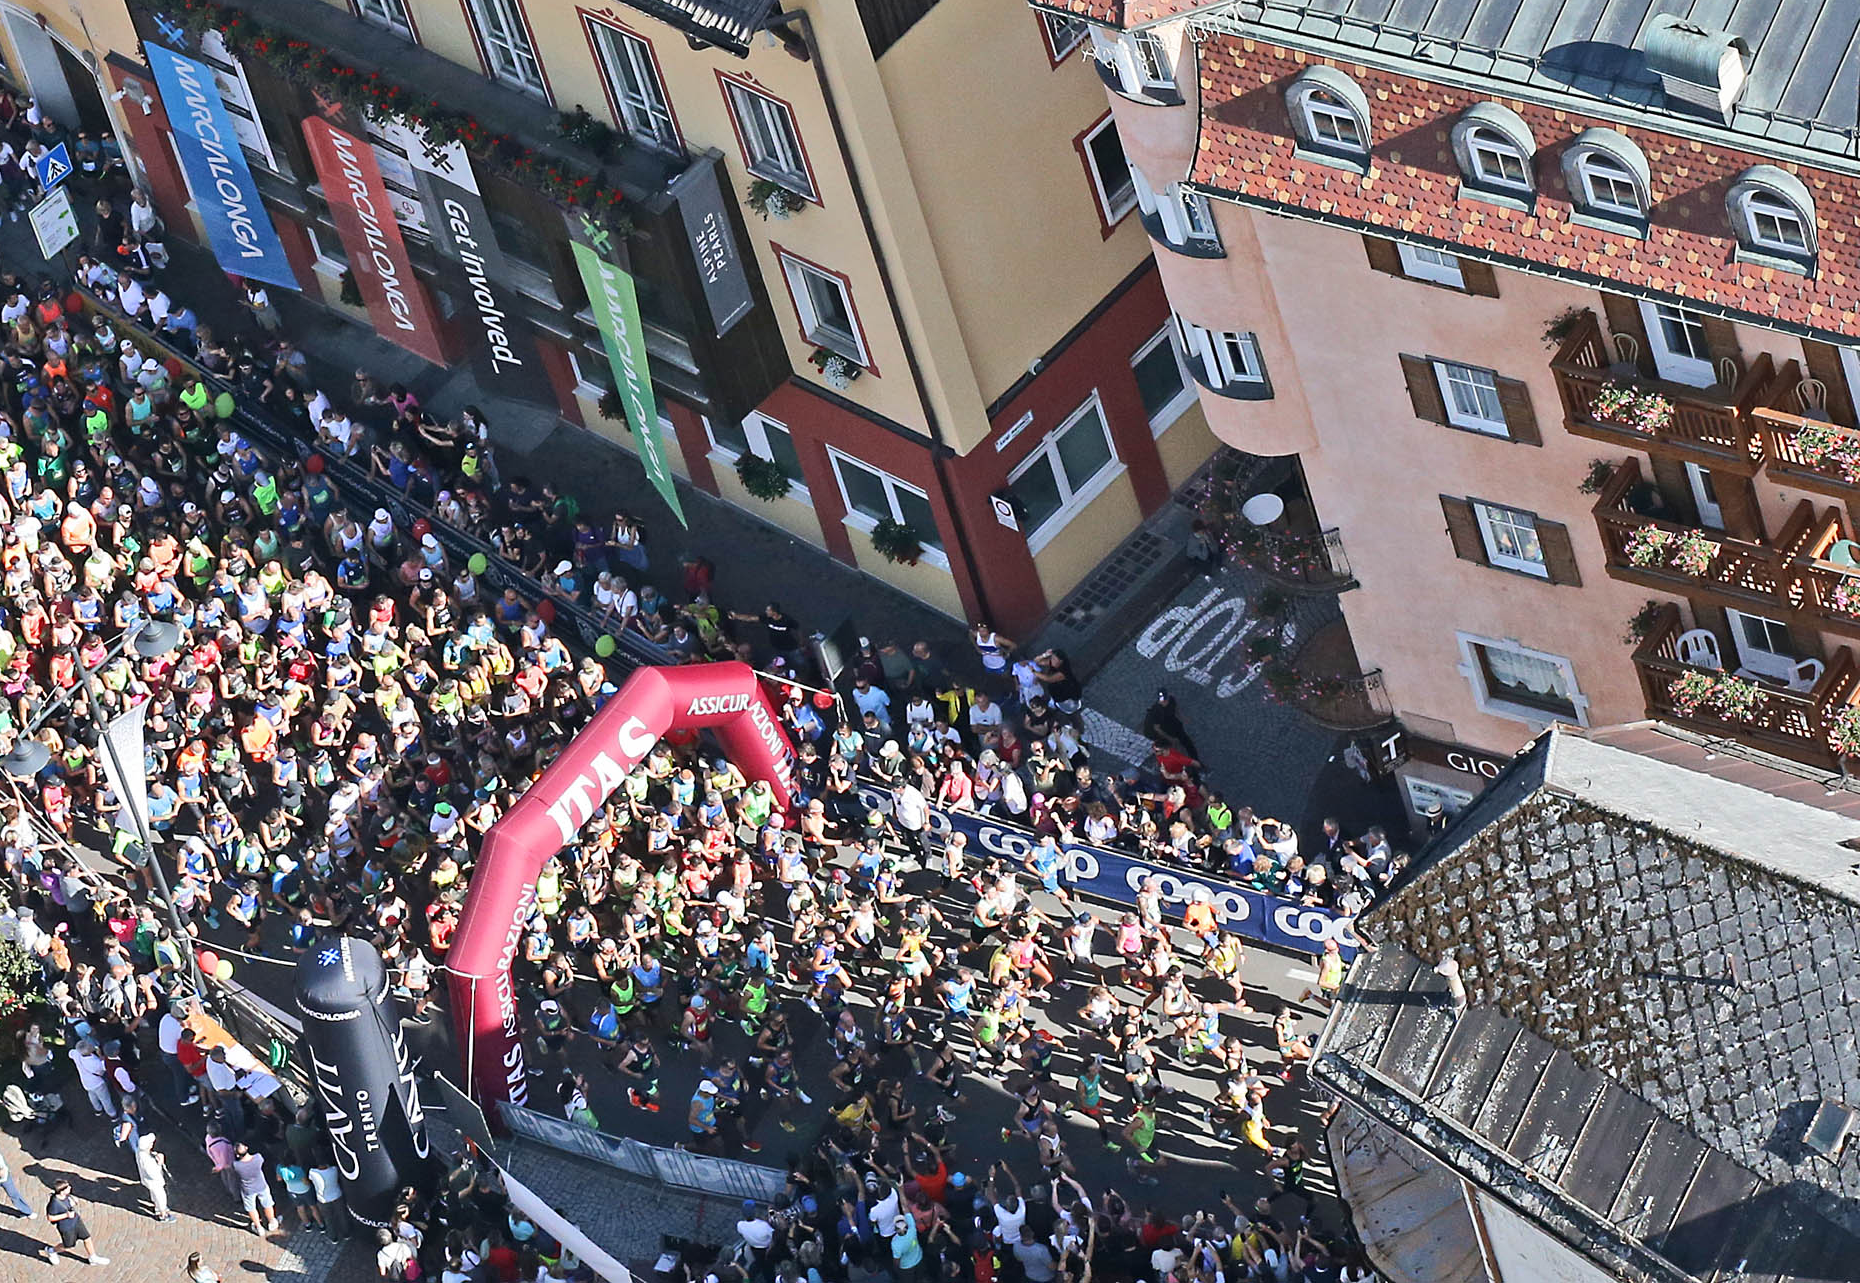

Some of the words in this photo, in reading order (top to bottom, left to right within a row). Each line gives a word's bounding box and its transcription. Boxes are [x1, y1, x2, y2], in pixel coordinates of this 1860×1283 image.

[696, 230, 718, 284] ALPINE
[704, 212, 727, 271] PEARLS
[544, 715, 657, 846] ITAS
[1446, 752, 1500, 780] GIO
[977, 825, 1101, 883] cop
[495, 882, 535, 1038] ASSICURAZIONI
[309, 1044, 361, 1180] CAVIT
[355, 1089, 381, 1153] TRENTO
